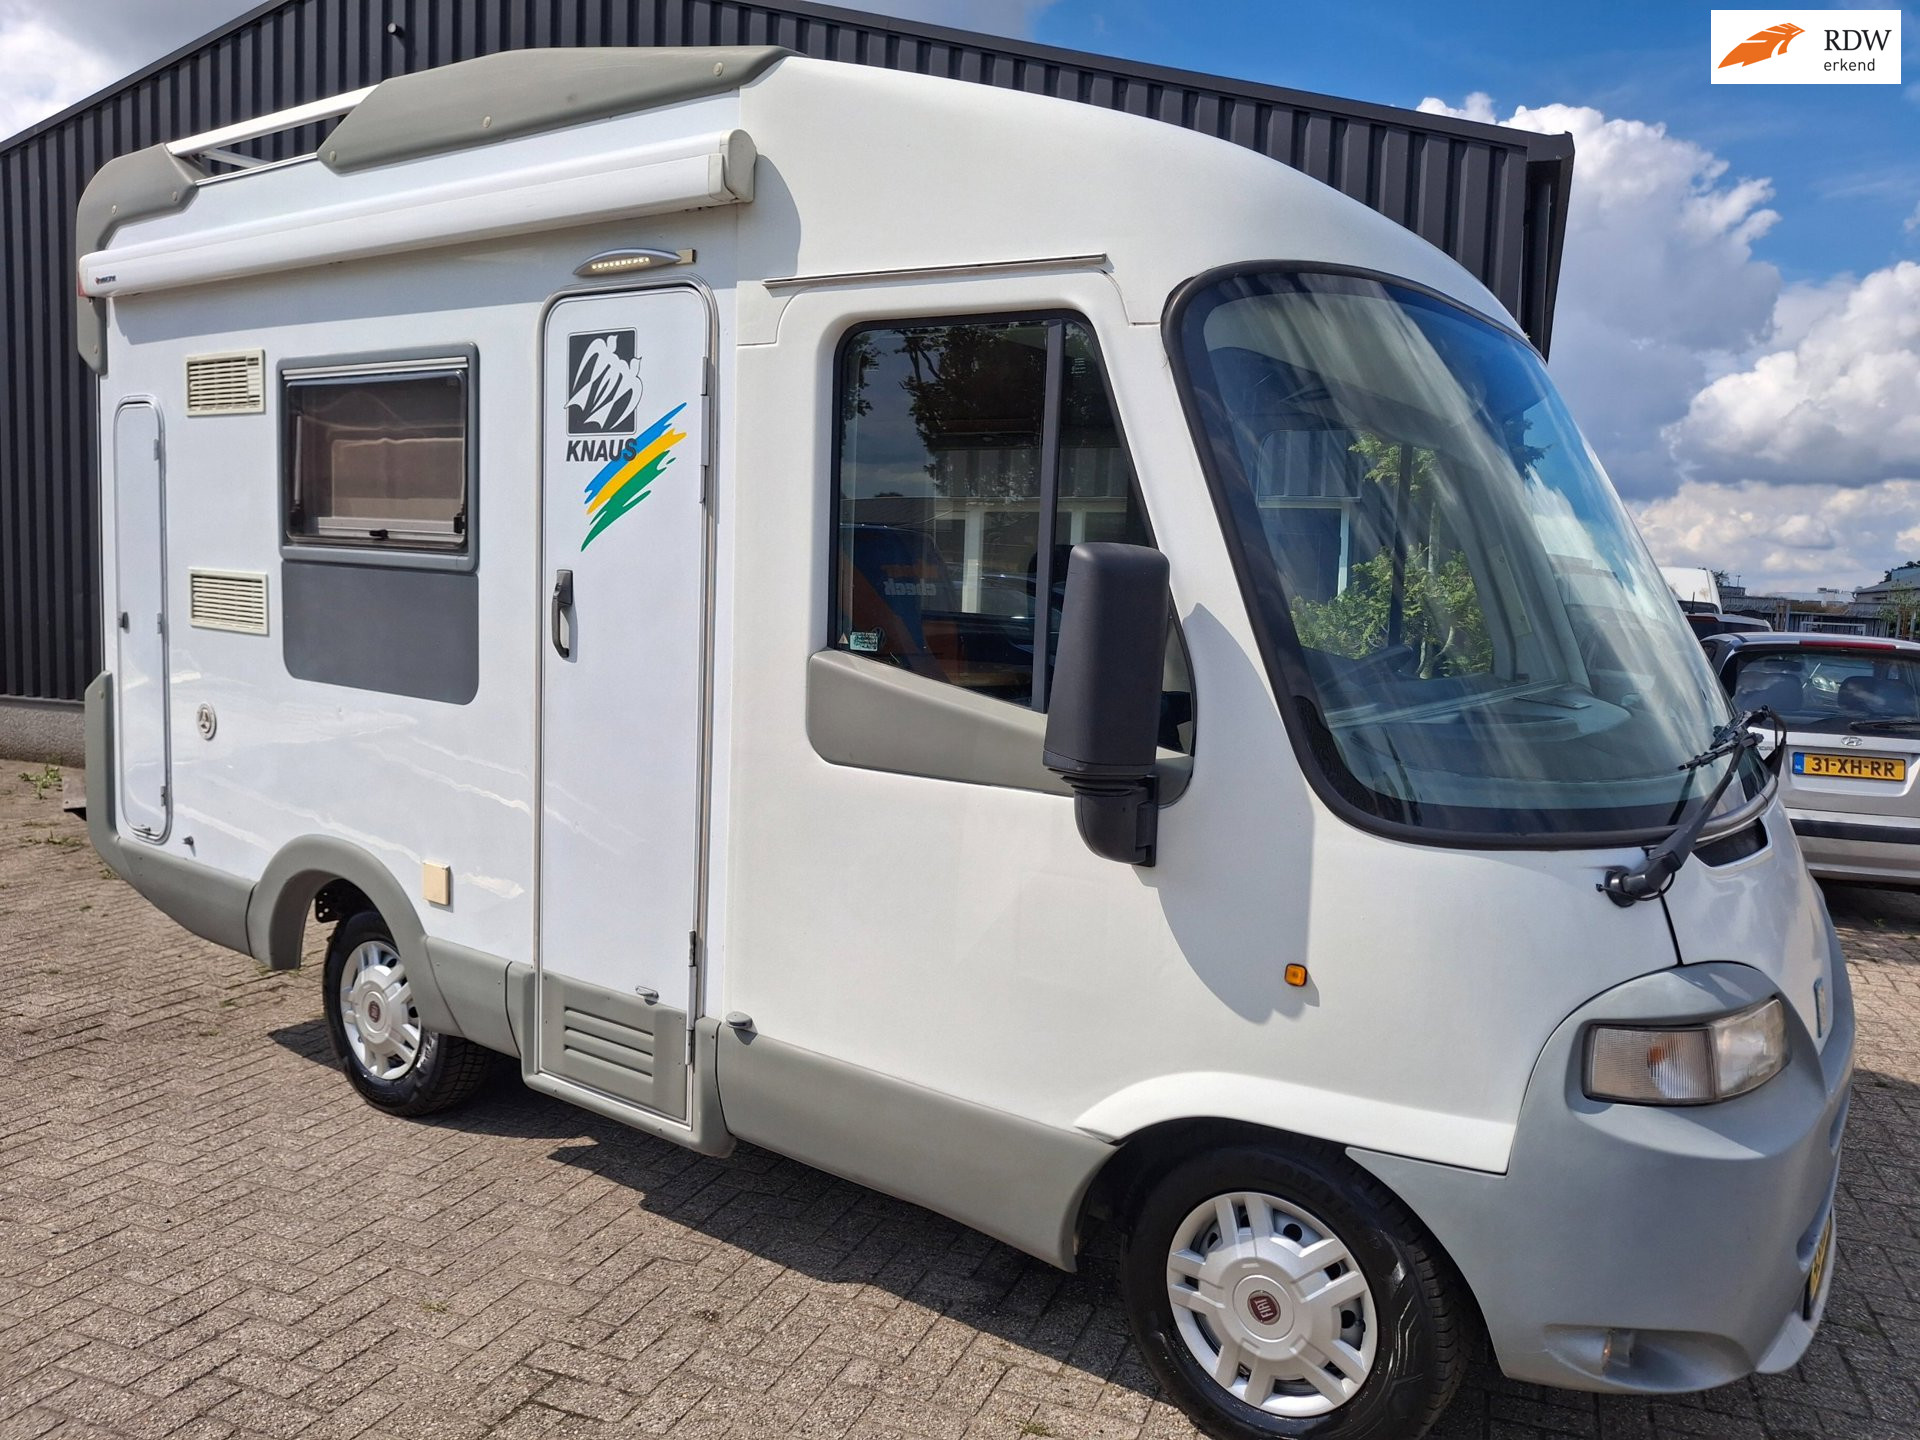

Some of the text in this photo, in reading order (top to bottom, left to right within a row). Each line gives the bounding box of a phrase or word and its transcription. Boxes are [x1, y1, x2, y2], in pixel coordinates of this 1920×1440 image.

[566, 438, 637, 462] KNAUS
[1812, 757, 1895, 777] 31-XH-RR
[1254, 1298, 1274, 1318] FIAT
